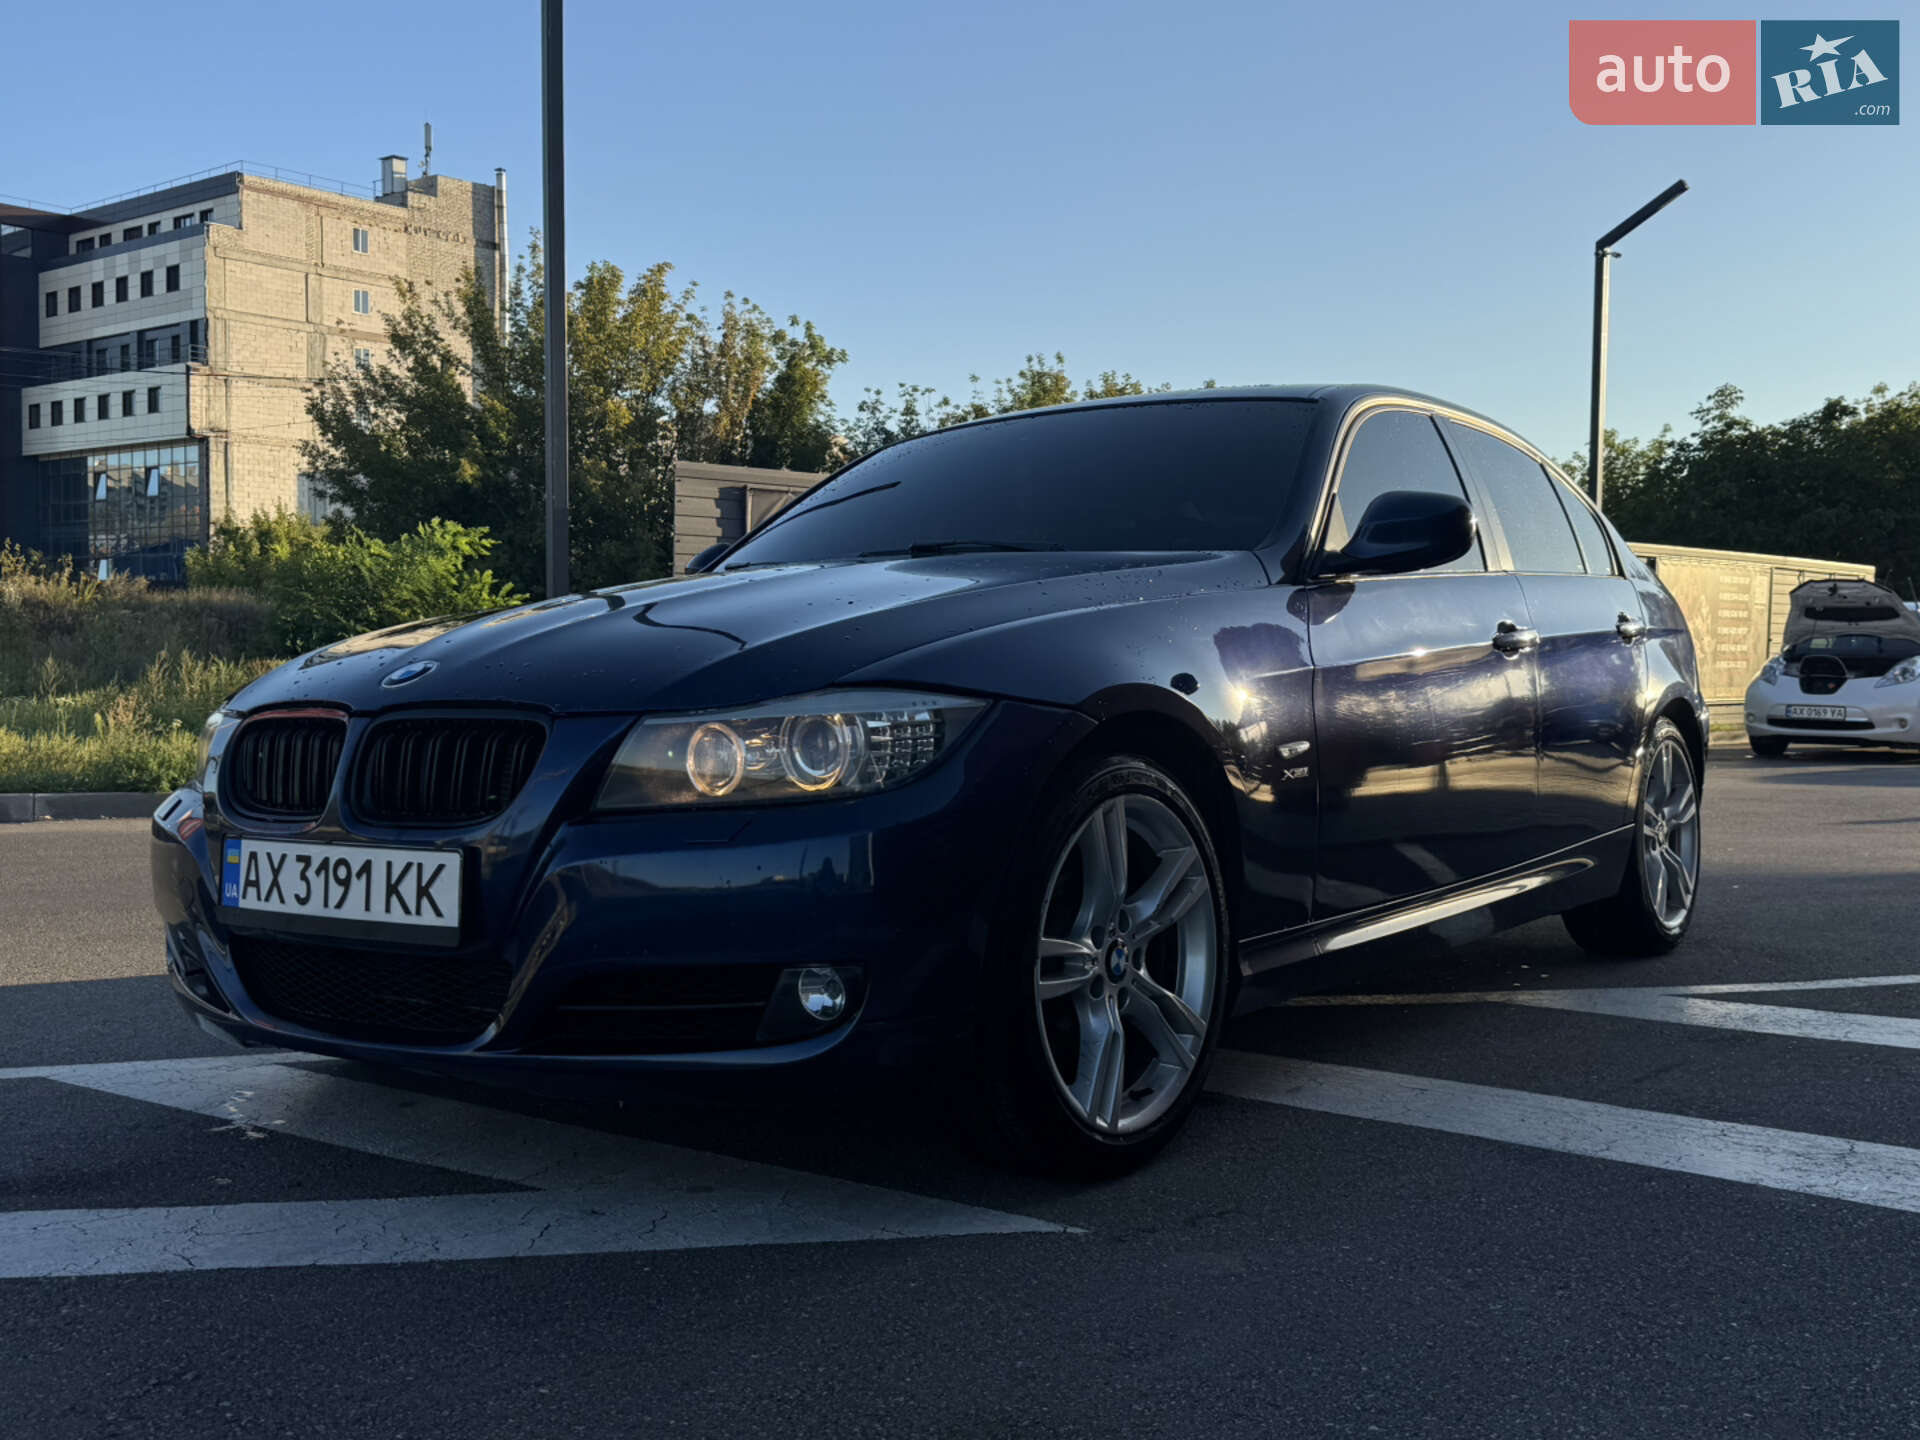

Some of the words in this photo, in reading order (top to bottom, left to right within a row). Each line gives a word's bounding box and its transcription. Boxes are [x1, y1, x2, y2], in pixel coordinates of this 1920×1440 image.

[224, 883, 238, 898] UA
[242, 850, 288, 903] AX
[294, 854, 373, 912] 3191
[384, 860, 447, 918] KK
